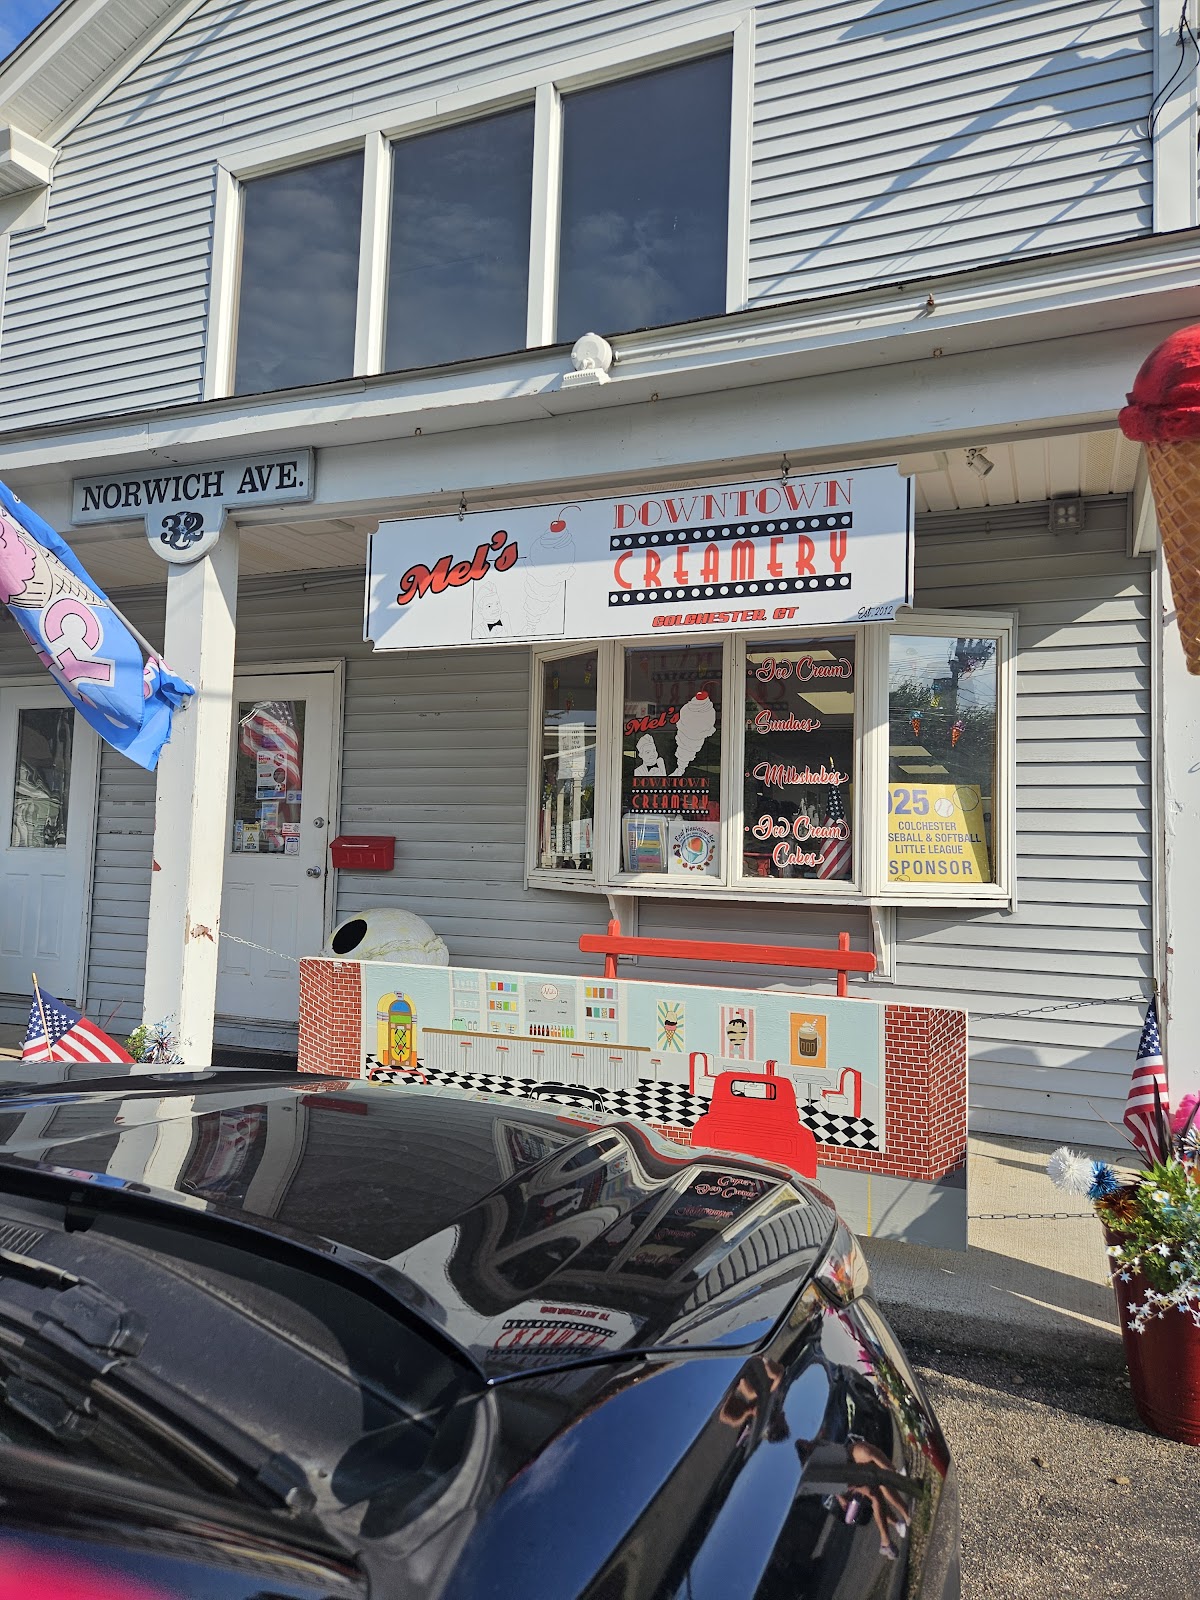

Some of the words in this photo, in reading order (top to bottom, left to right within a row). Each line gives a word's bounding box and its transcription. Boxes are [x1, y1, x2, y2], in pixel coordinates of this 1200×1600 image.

[81, 470, 225, 511] NORWICH
[236, 461, 304, 494] AVE.
[613, 478, 854, 530] DOWNTOWN
[397, 530, 519, 605] Mel's
[613, 530, 848, 589] CREAMERY
[772, 606, 800, 620] CT
[857, 606, 874, 620] Est.
[874, 605, 894, 616] 2012
[755, 656, 793, 682] Ice
[796, 655, 852, 682] Cream
[624, 706, 680, 737] Mel's
[755, 709, 821, 735] Sundaes
[632, 777, 710, 788] DOWNTOWN
[752, 761, 850, 789] Milkshakes
[632, 794, 709, 809] CREAMERY
[888, 788, 930, 816] 25
[752, 814, 791, 841] Ice
[793, 815, 851, 842] Cream
[888, 832, 923, 842] SEBALL
[925, 833, 933, 842] &
[935, 833, 982, 843] SOFTBALL
[898, 821, 957, 831] COLCHESTER
[772, 841, 825, 868] Cakes
[895, 844, 926, 854] LITTLE
[928, 845, 964, 855] LEAGUE
[889, 860, 974, 875] SPONSOR
